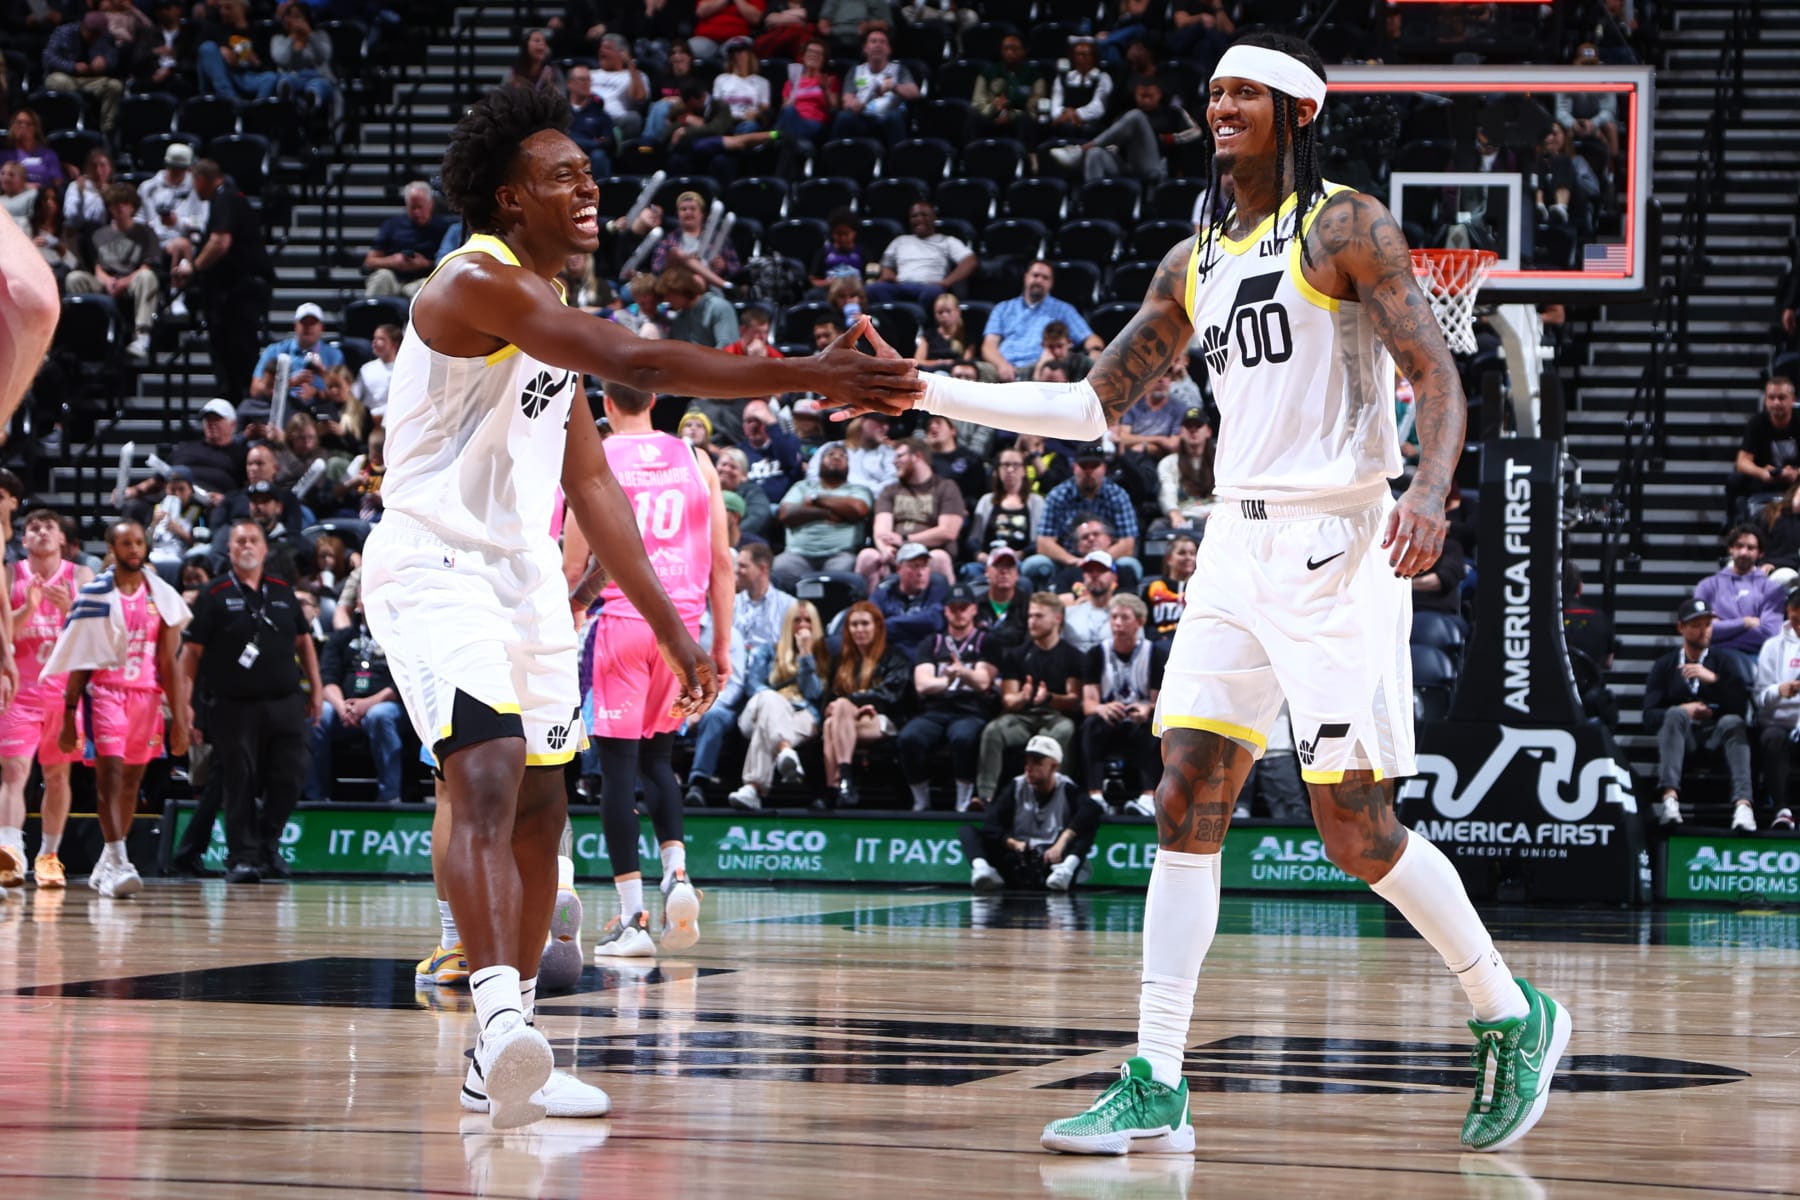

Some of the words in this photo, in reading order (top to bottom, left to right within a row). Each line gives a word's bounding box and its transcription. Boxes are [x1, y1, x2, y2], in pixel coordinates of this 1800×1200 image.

[1236, 303, 1293, 367] 00
[617, 466, 690, 487] ABERCROMBIE
[634, 489, 684, 539] 10
[1240, 499, 1267, 520] UTAH
[1504, 458, 1532, 554] FIRST
[1153, 602, 1184, 623] UTA
[1504, 559, 1531, 714] AMERICA
[329, 830, 356, 855] IT
[362, 830, 432, 856] PAYS
[719, 826, 827, 852] ALSCO
[1413, 821, 1531, 844] AMERICA
[1536, 824, 1615, 845] FIRST
[576, 833, 660, 860] CLA
[855, 838, 882, 864] IT
[889, 838, 963, 865] PAYS
[1107, 843, 1159, 869] CLE
[1250, 836, 1328, 862] ALS
[1456, 847, 1512, 856] CREDIT
[1520, 848, 1568, 857] UNION
[718, 854, 822, 871] UNIFORMS
[1688, 846, 1800, 874] ALSCO
[1688, 875, 1798, 893] UNIFORMS
